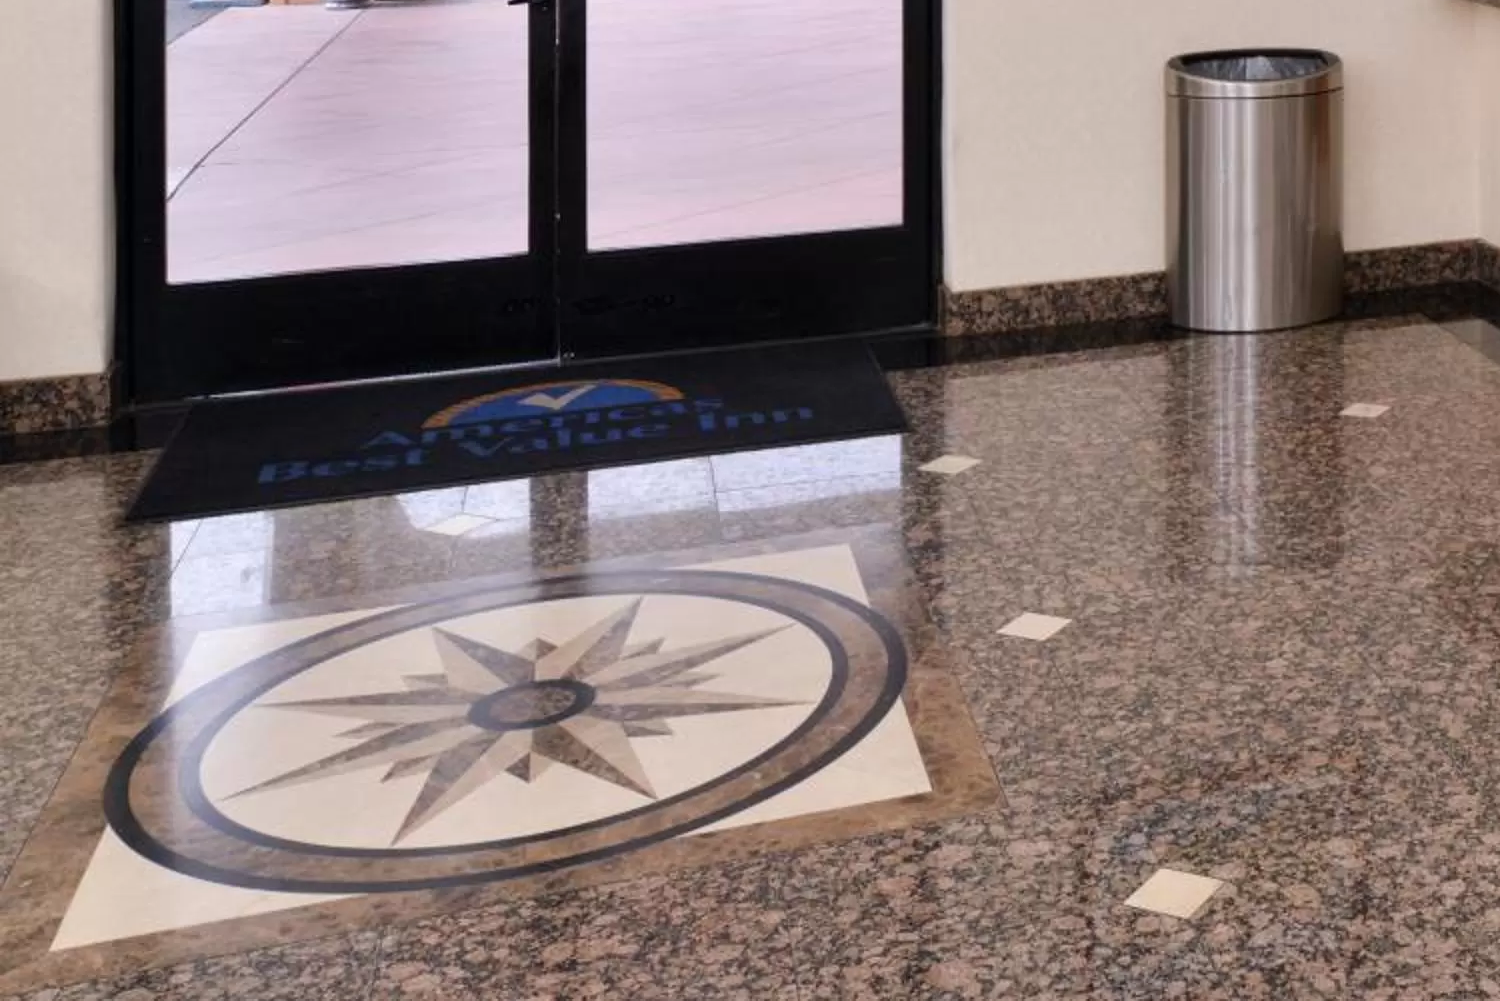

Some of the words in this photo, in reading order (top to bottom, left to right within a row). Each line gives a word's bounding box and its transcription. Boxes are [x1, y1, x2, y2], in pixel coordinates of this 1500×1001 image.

[258, 448, 428, 482] Best
[455, 422, 670, 458] Value
[697, 406, 814, 431] Inn
